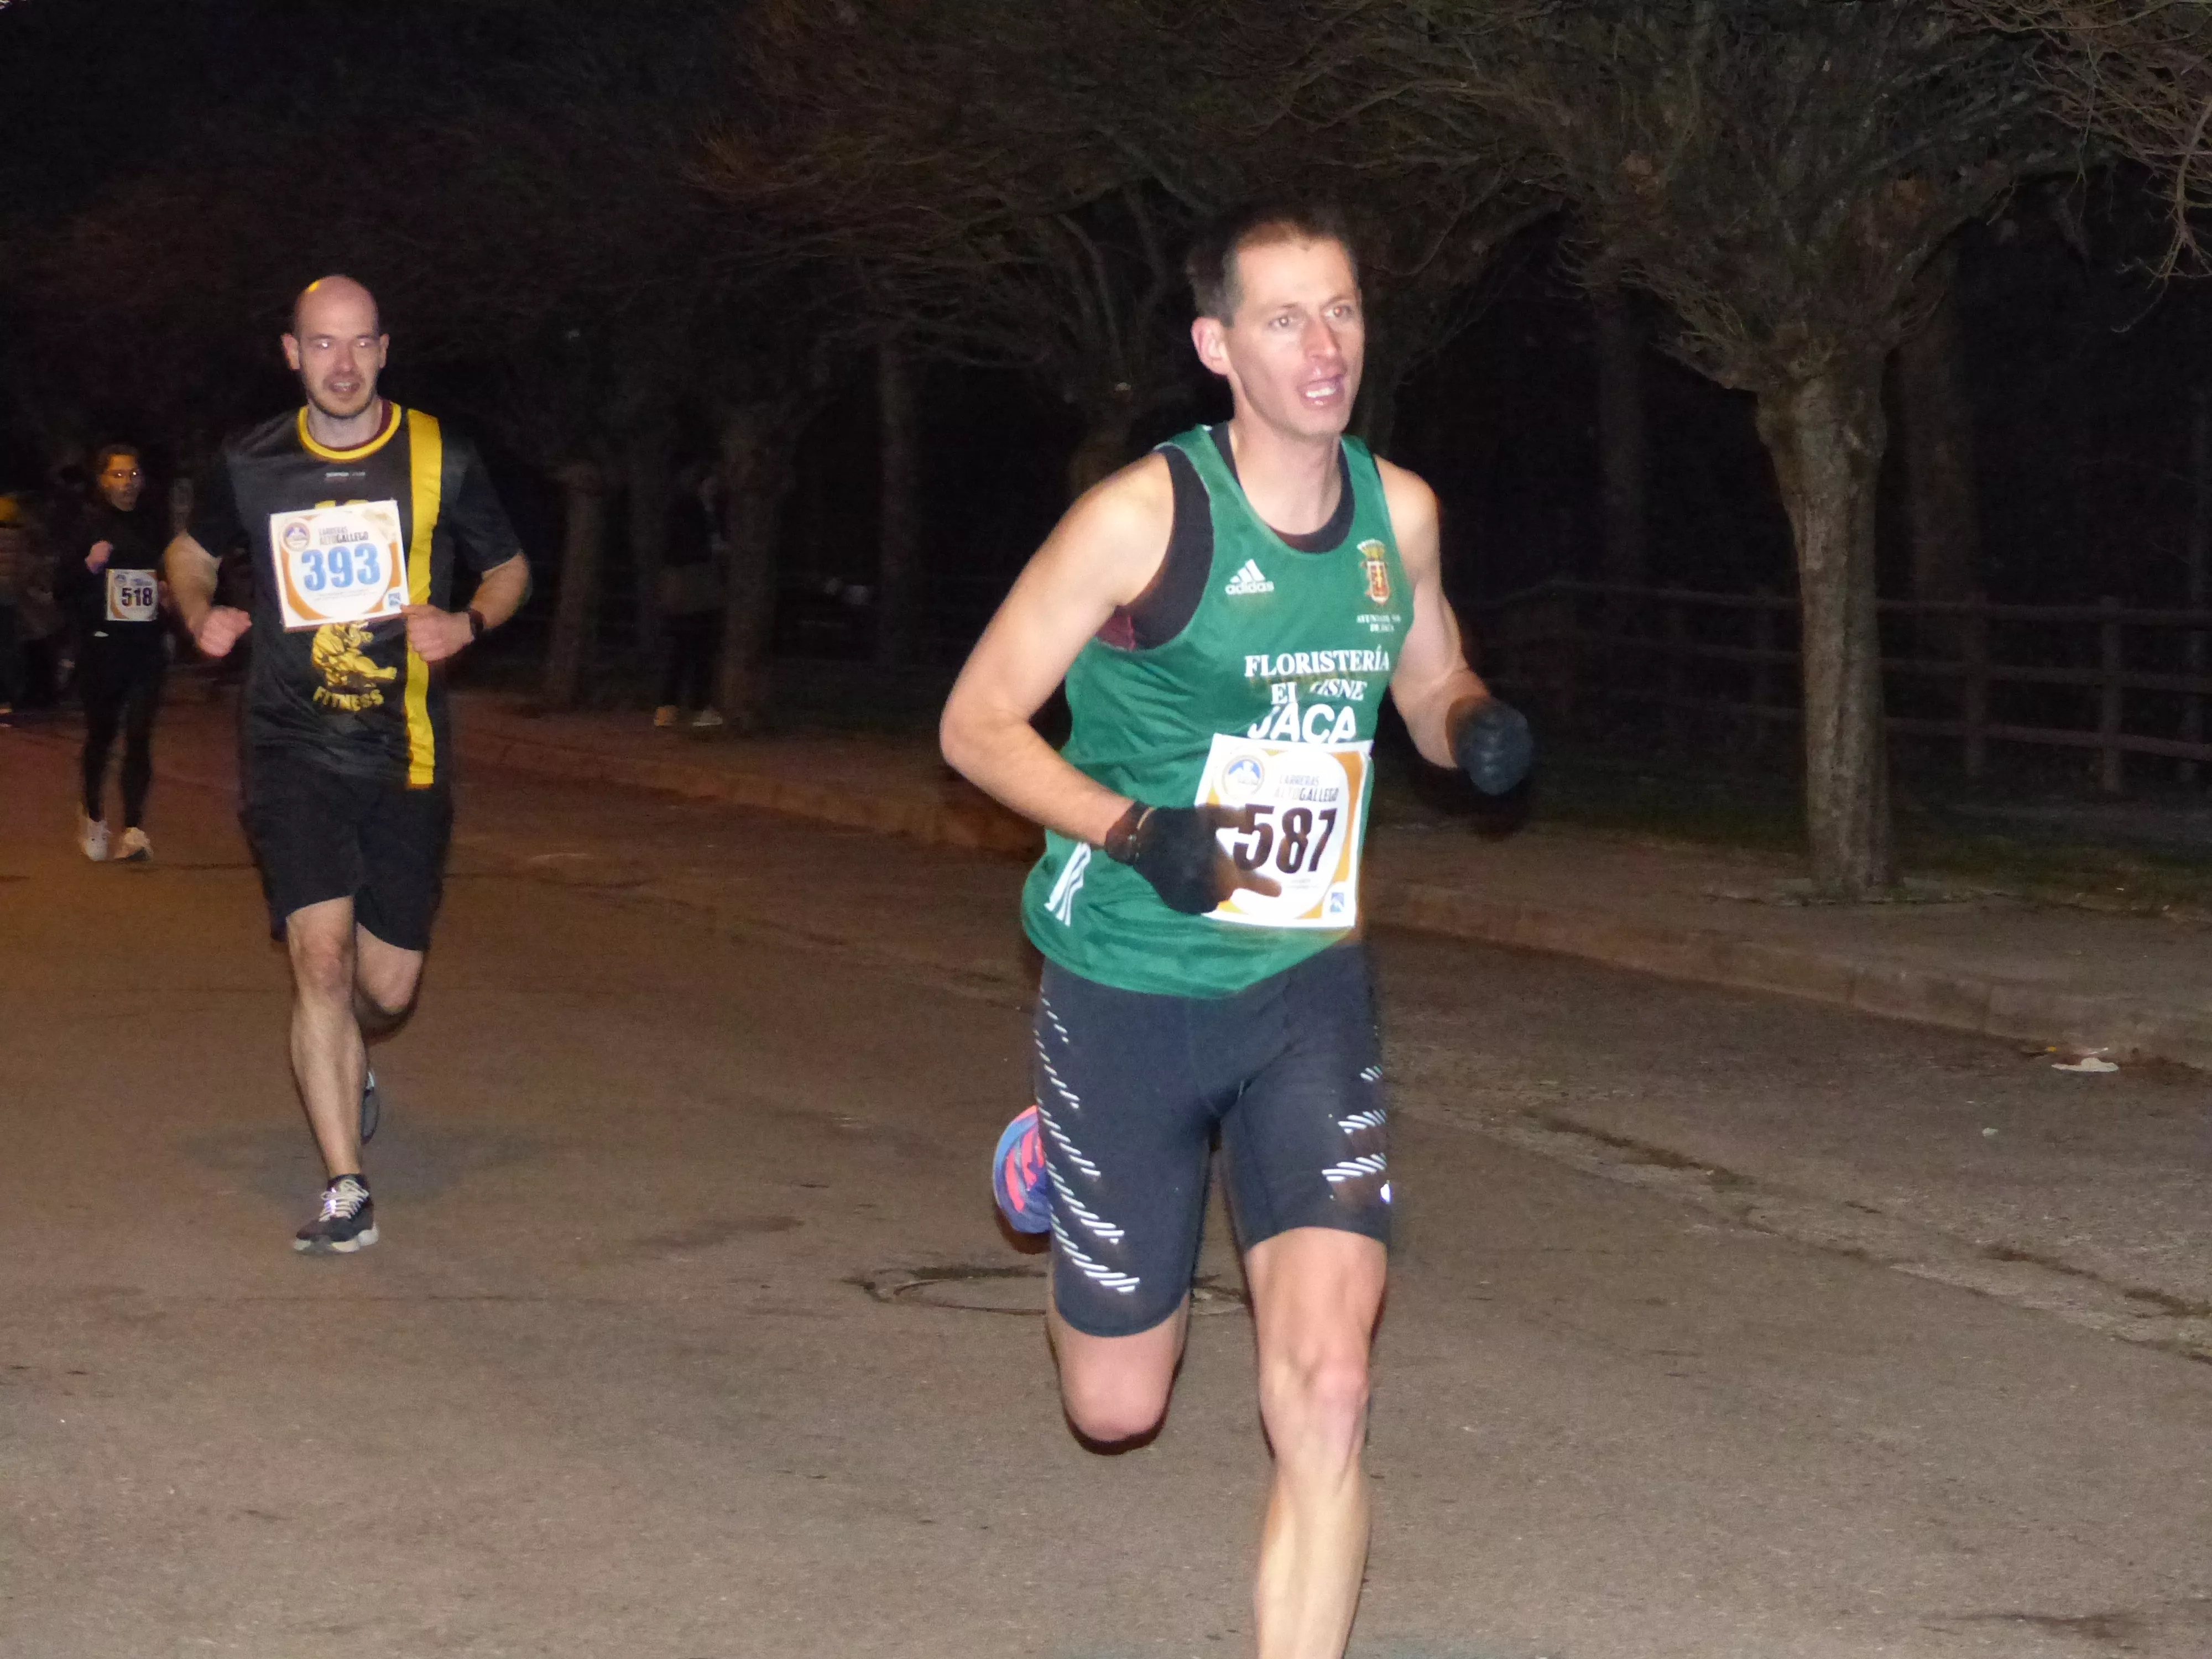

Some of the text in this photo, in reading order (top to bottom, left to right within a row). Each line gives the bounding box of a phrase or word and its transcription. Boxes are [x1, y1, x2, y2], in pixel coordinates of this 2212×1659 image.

[301, 542, 380, 591] 393
[122, 587, 153, 606] 518
[1225, 581, 1275, 595] adidas
[1244, 644, 1390, 677] FLORISTERÍA
[313, 686, 384, 711] FITNESS
[1248, 702, 1357, 744] JACA
[1233, 803, 1338, 874] 587
